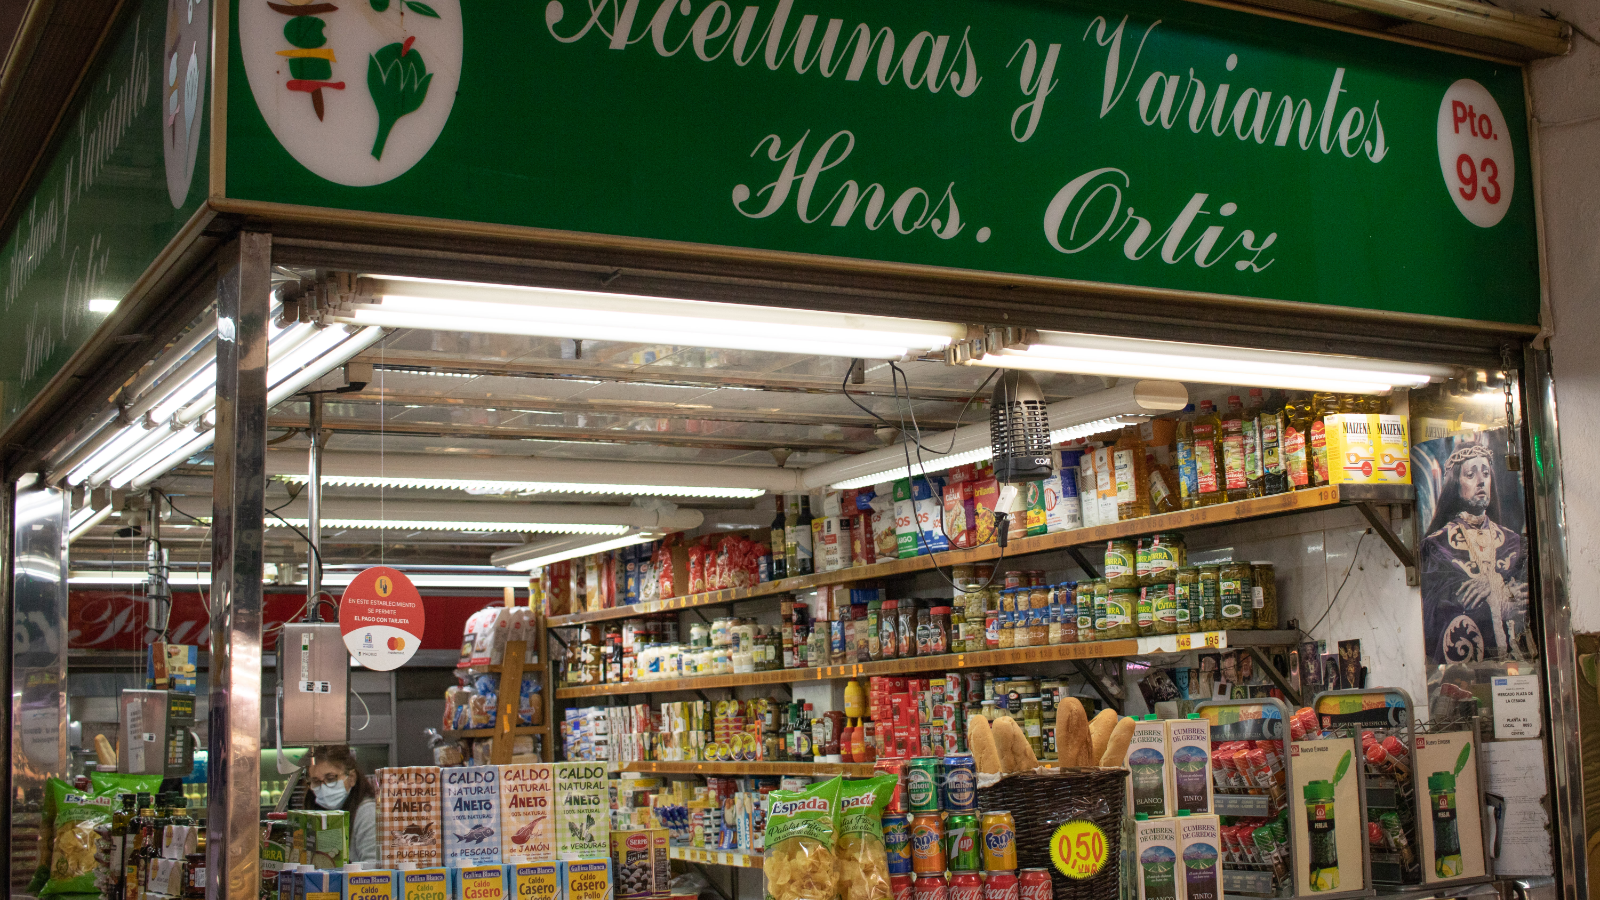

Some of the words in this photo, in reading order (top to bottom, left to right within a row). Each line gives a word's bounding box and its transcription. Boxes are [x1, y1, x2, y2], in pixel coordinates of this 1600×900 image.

[1005, 38, 1062, 143] y
[1083, 14, 1389, 163] Variantes
[1451, 100, 1498, 141] Pto.
[1455, 154, 1501, 205] 93
[732, 129, 991, 243] Hnos.
[1043, 167, 1278, 273] Ortiz
[1342, 421, 1371, 434] MAIZENA
[1376, 422, 1406, 435] MAIZENA
[974, 486, 996, 497] brillante
[370, 600, 416, 608] ESTABLECIMIENTO
[1176, 637, 1191, 647] 145
[1205, 635, 1219, 645] 195
[1133, 729, 1161, 737] UMBRES
[387, 772, 436, 785] CALDO
[448, 771, 495, 784] CALDO
[504, 768, 550, 781] CALDO
[559, 767, 604, 780] CALDO
[448, 786, 497, 796] NATURAL
[504, 783, 551, 793] NATURAL
[559, 781, 605, 791] NATURAL
[387, 788, 437, 797] NATURAL
[1136, 797, 1163, 805] BLANCO
[772, 798, 828, 815] Espada
[518, 842, 550, 852] JAMÓN
[570, 842, 607, 850] VERDURAS
[949, 827, 966, 860] 7
[396, 850, 437, 859] PUCHERO
[460, 847, 499, 857] PESCADO
[1058, 831, 1103, 869] 0,50
[519, 867, 537, 875] Gallina
[570, 864, 588, 872] Gallina
[1077, 863, 1098, 873] UNA
[407, 875, 426, 883] Gallina
[464, 871, 482, 879] Gallina
[528, 876, 545, 884] Caldo
[351, 877, 371, 885] Gallina
[473, 880, 490, 888] Caldo
[570, 879, 606, 891] Casero
[361, 886, 379, 894] Caldo
[416, 884, 434, 892] Caldo
[464, 886, 501, 899] Casero
[519, 883, 555, 895] Casero
[407, 890, 445, 900] Casero
[584, 892, 601, 900] Pollo
